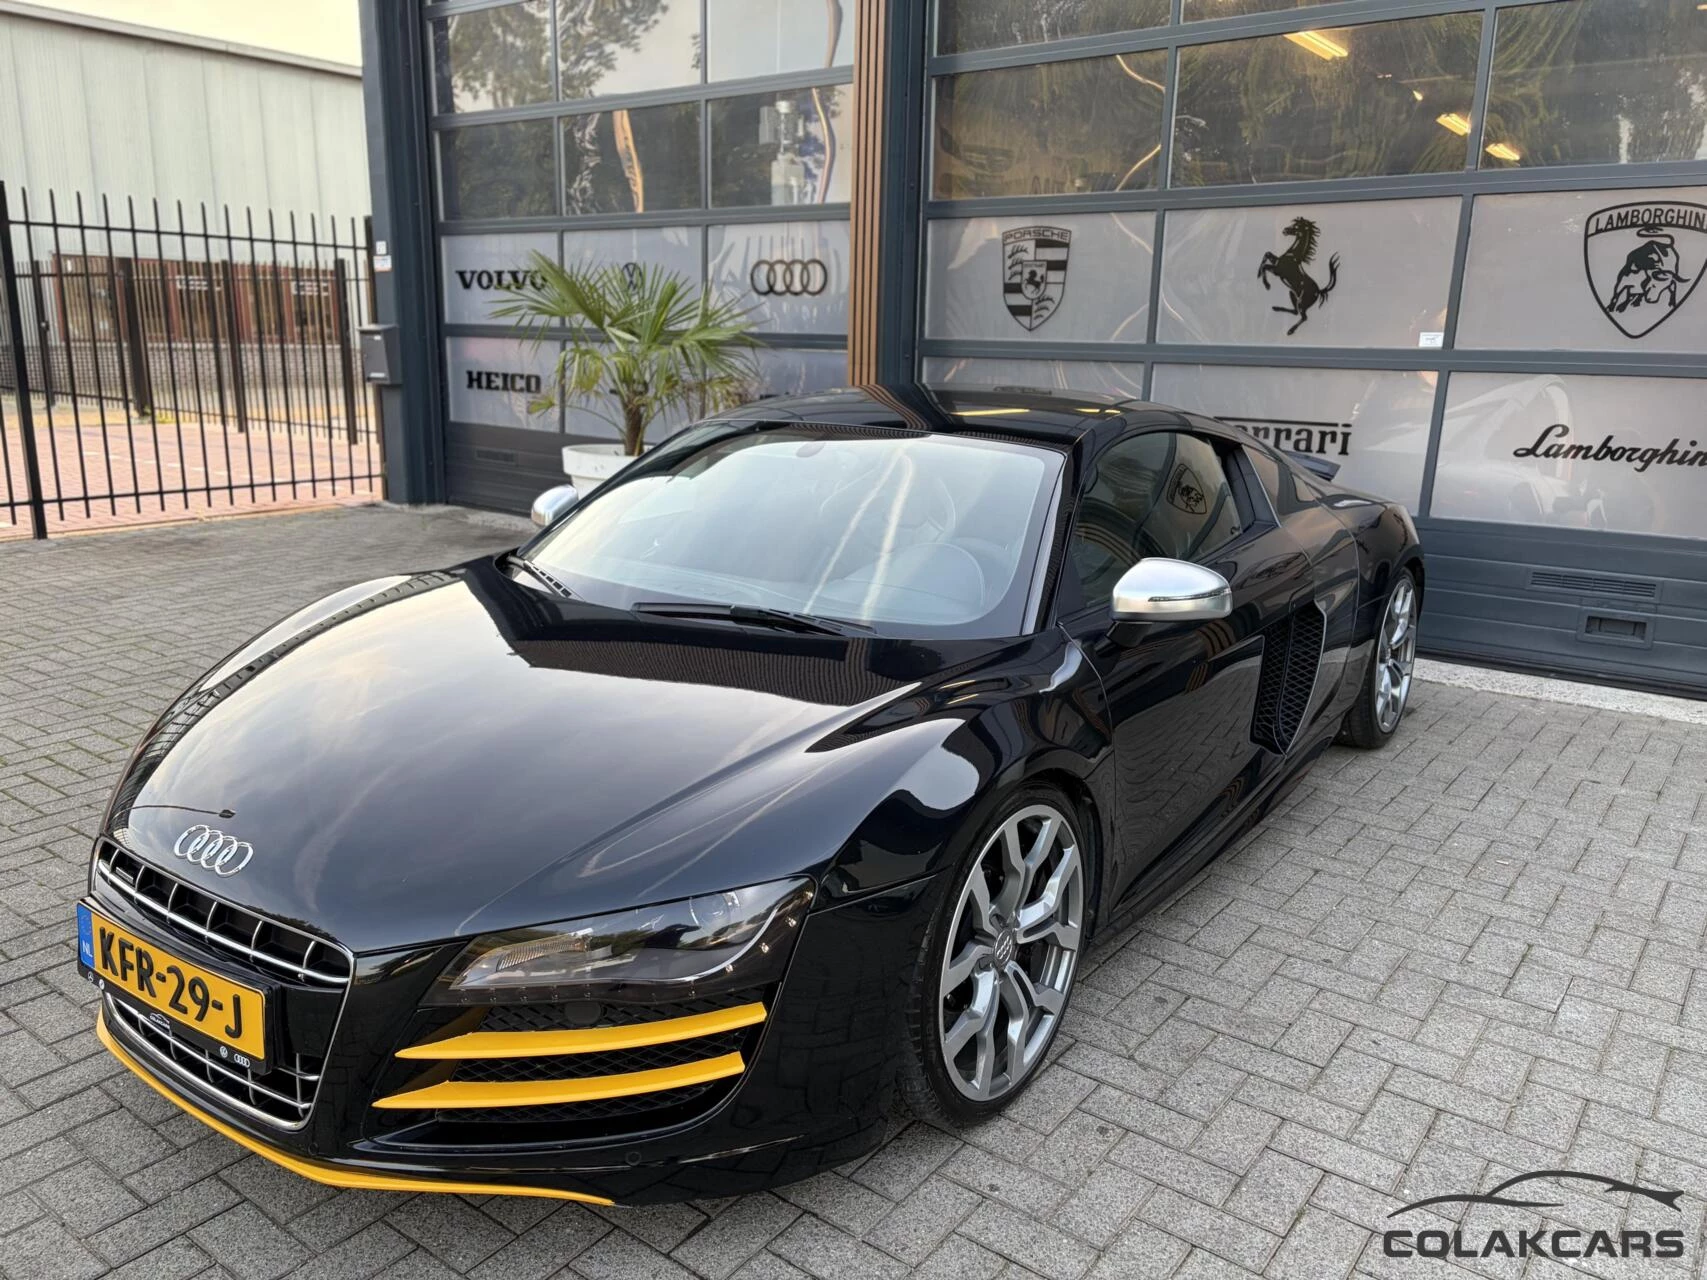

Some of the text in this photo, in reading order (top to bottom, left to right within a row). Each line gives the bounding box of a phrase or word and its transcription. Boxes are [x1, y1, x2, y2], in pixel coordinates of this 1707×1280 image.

[1004, 229, 1069, 241] PORSCHE
[455, 270, 548, 291] VOLVO
[466, 370, 542, 394] HEICO
[82, 939, 93, 958] NL
[99, 927, 243, 1039] KFR-29-J
